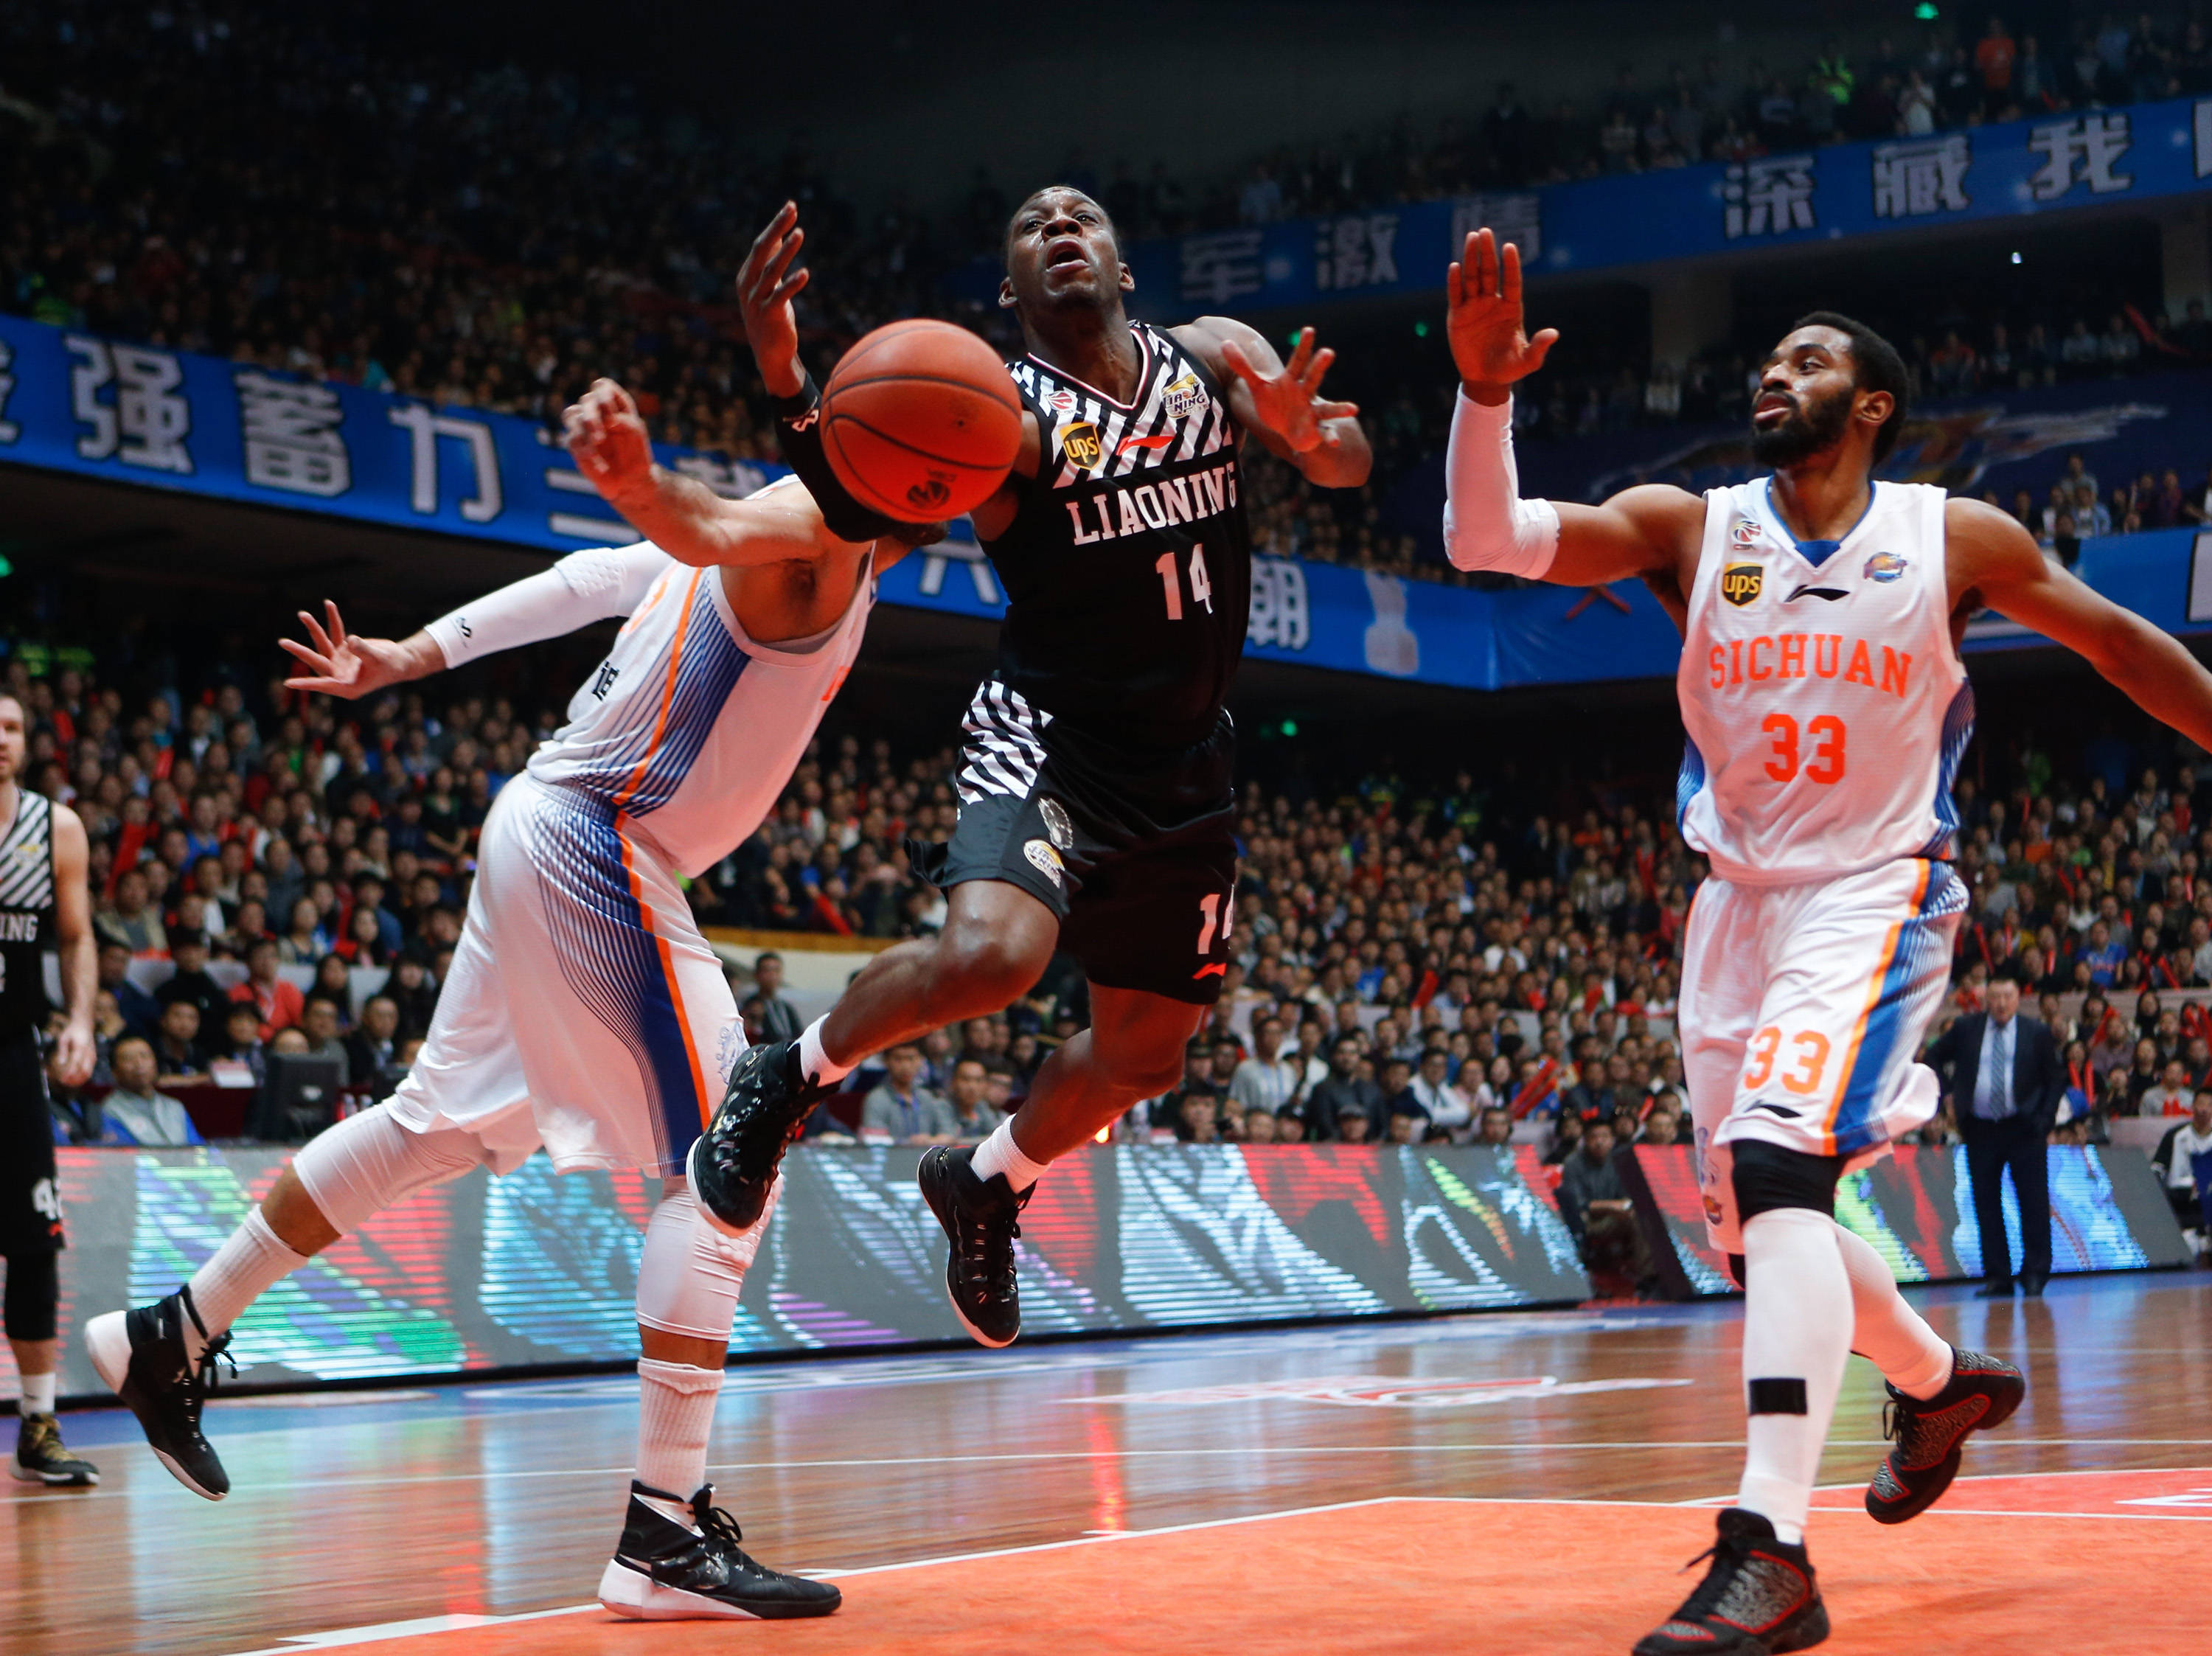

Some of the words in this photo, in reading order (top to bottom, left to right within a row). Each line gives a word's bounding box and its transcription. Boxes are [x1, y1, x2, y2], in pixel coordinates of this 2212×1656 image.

[1724, 100, 2212, 239] 深藏我
[1065, 436, 1099, 464] ups
[1065, 462, 1237, 546] LIAONING
[1155, 543, 1213, 621] 14
[1724, 574, 1761, 601] ups
[1709, 633, 1913, 699] SICHUAN
[1761, 713, 1847, 785] 33
[1744, 1026, 1832, 1095] 33
[32, 1177, 63, 1220] 4
